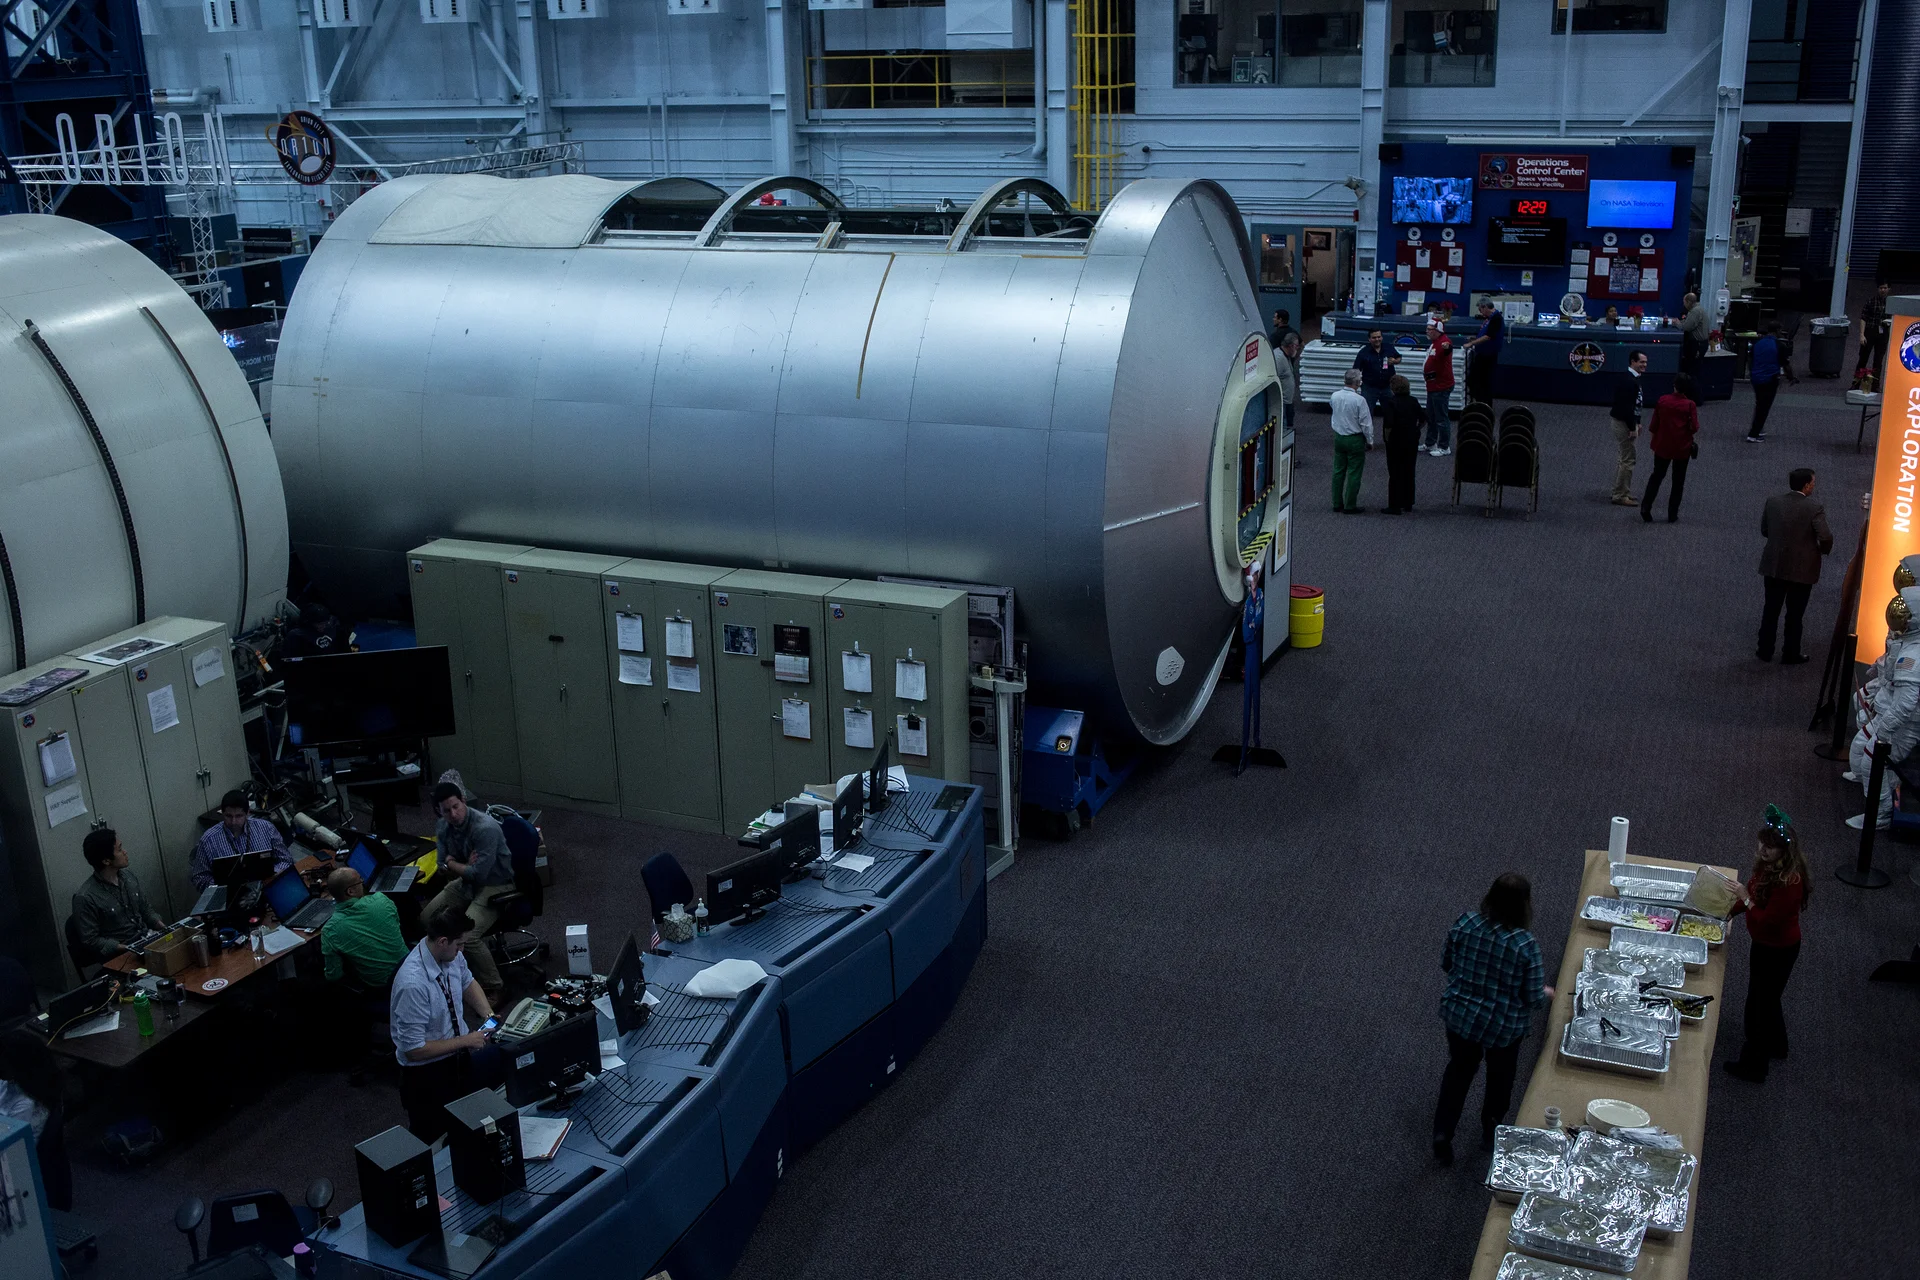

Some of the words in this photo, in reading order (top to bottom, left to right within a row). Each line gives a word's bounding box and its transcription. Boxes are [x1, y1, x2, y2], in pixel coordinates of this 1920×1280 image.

[55, 112, 233, 186] ORION
[1517, 157, 1569, 168] Operations
[1516, 166, 1551, 175] Control
[1553, 167, 1585, 176] Center
[1517, 200, 1548, 214] 12:29
[1893, 387, 1920, 534] EXPLORATION
